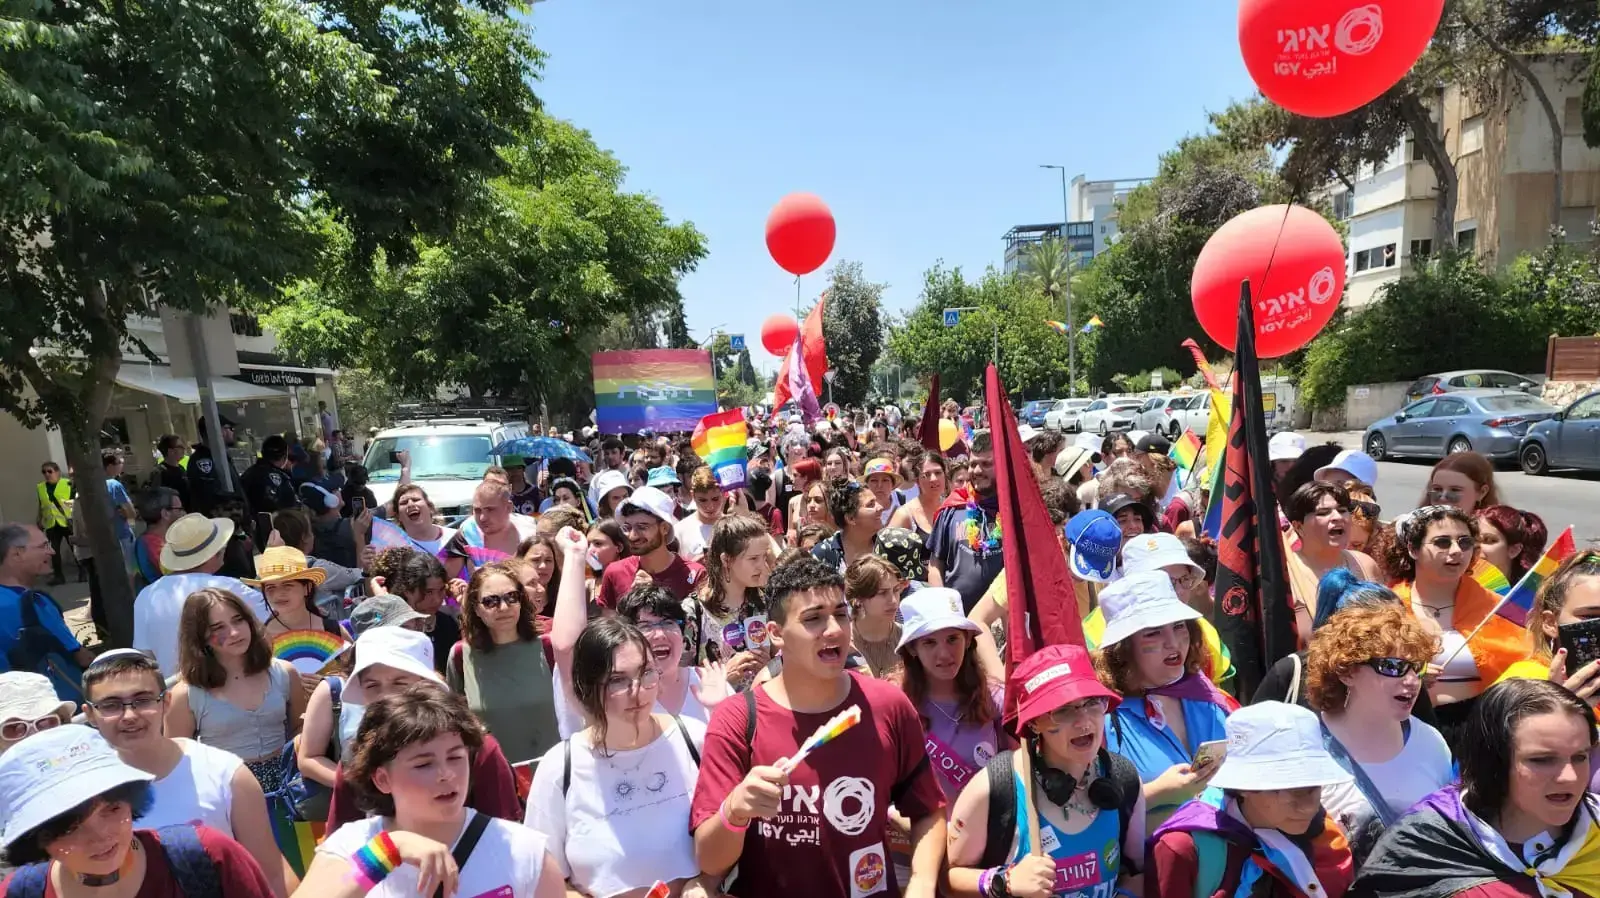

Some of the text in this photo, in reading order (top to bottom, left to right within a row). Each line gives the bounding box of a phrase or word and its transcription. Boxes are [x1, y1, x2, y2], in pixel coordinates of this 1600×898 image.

[1277, 24, 1330, 52] איגי
[1274, 61, 1301, 75] IGY
[1259, 286, 1305, 316] איגי
[1260, 319, 1285, 334] IGY
[777, 784, 820, 814] אי
[777, 814, 794, 824] נוער
[797, 815, 819, 825] ארגון
[758, 821, 784, 839] IGY
[786, 826, 820, 846] إيجي
